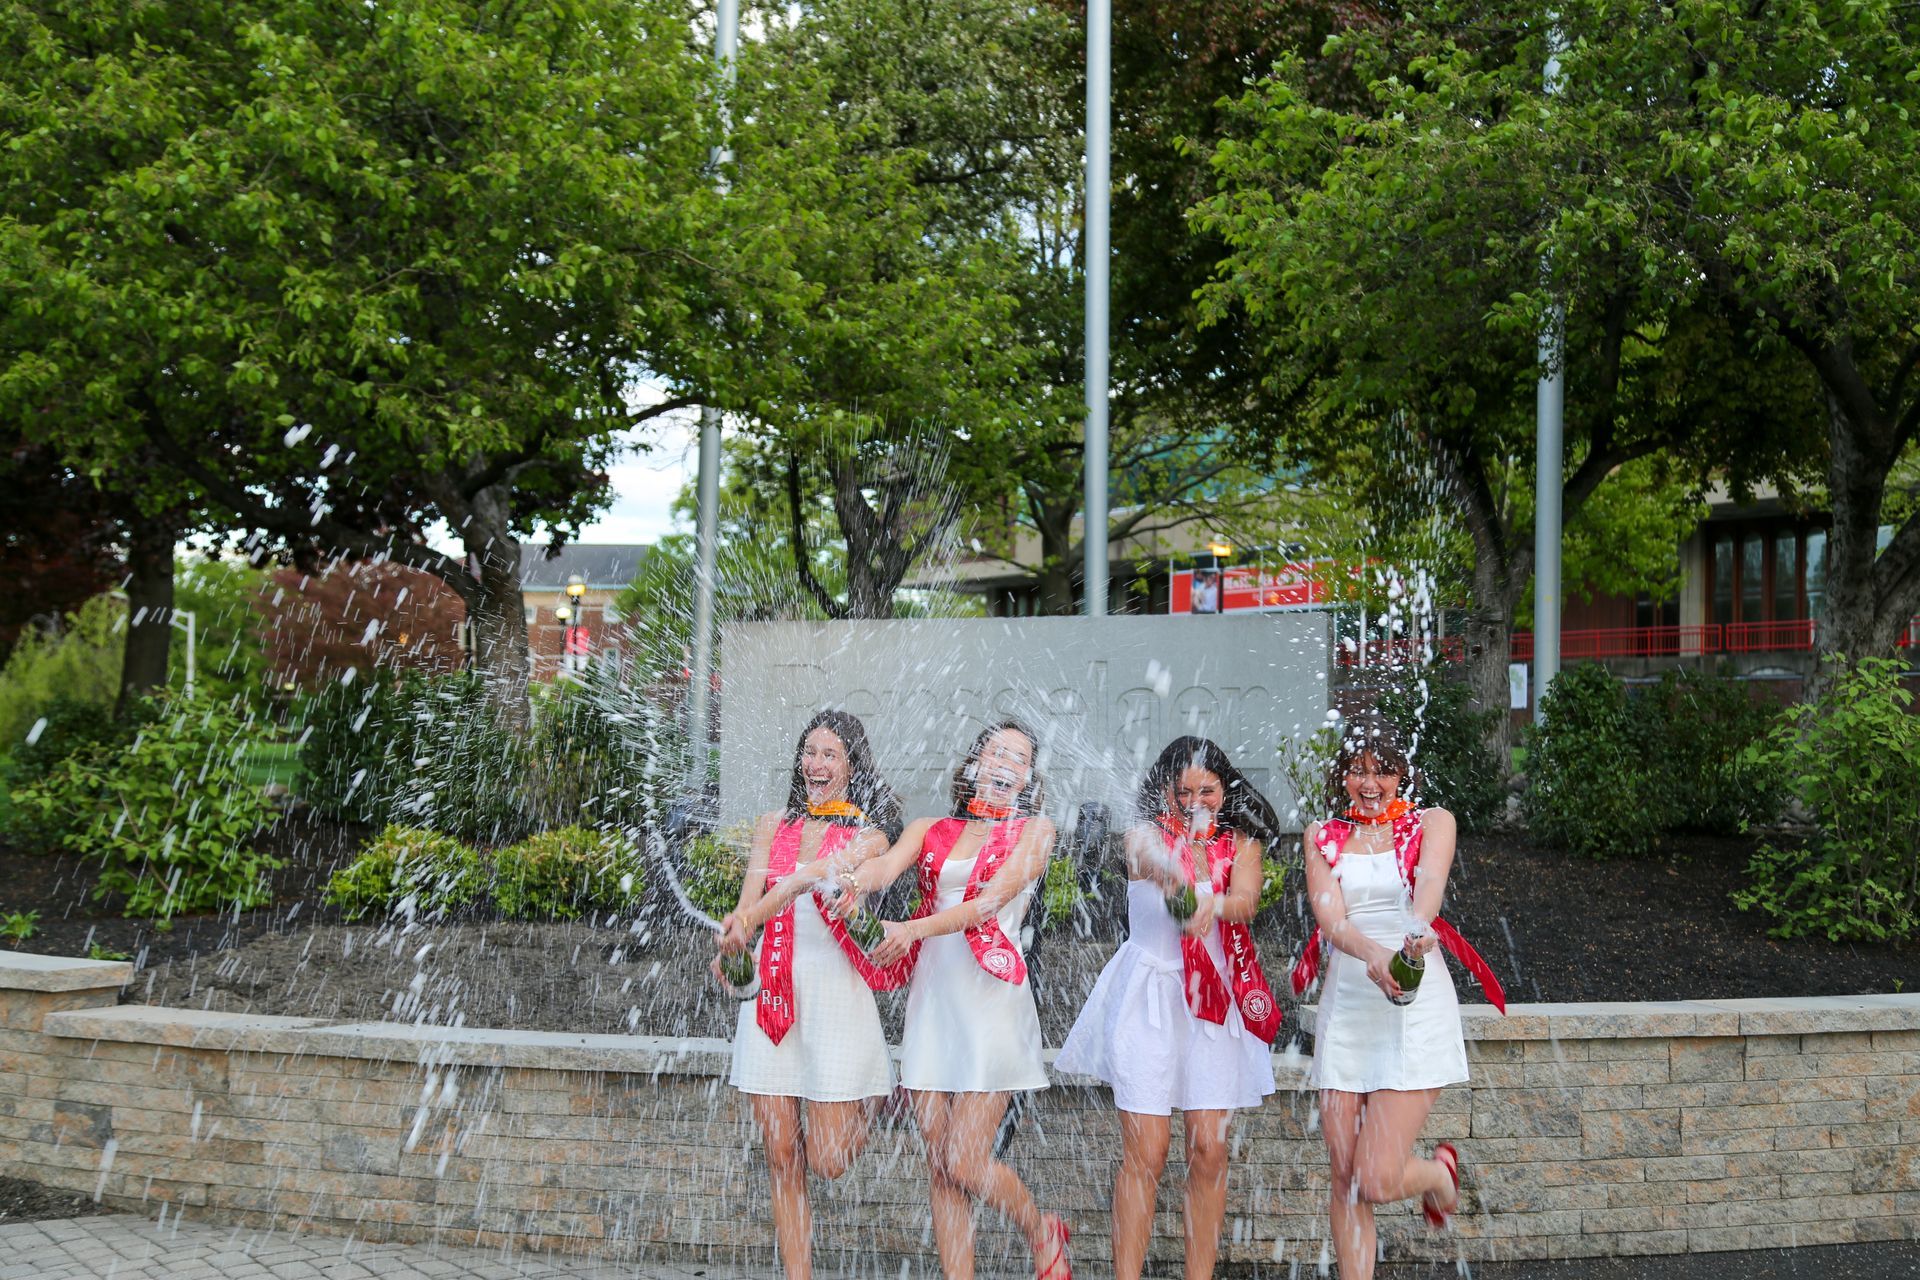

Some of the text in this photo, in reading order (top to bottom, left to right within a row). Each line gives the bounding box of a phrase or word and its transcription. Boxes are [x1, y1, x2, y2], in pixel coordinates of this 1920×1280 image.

[769, 876, 784, 977] SUDENT
[1230, 921, 1251, 983] LETE
[761, 989, 789, 1018] RPI
